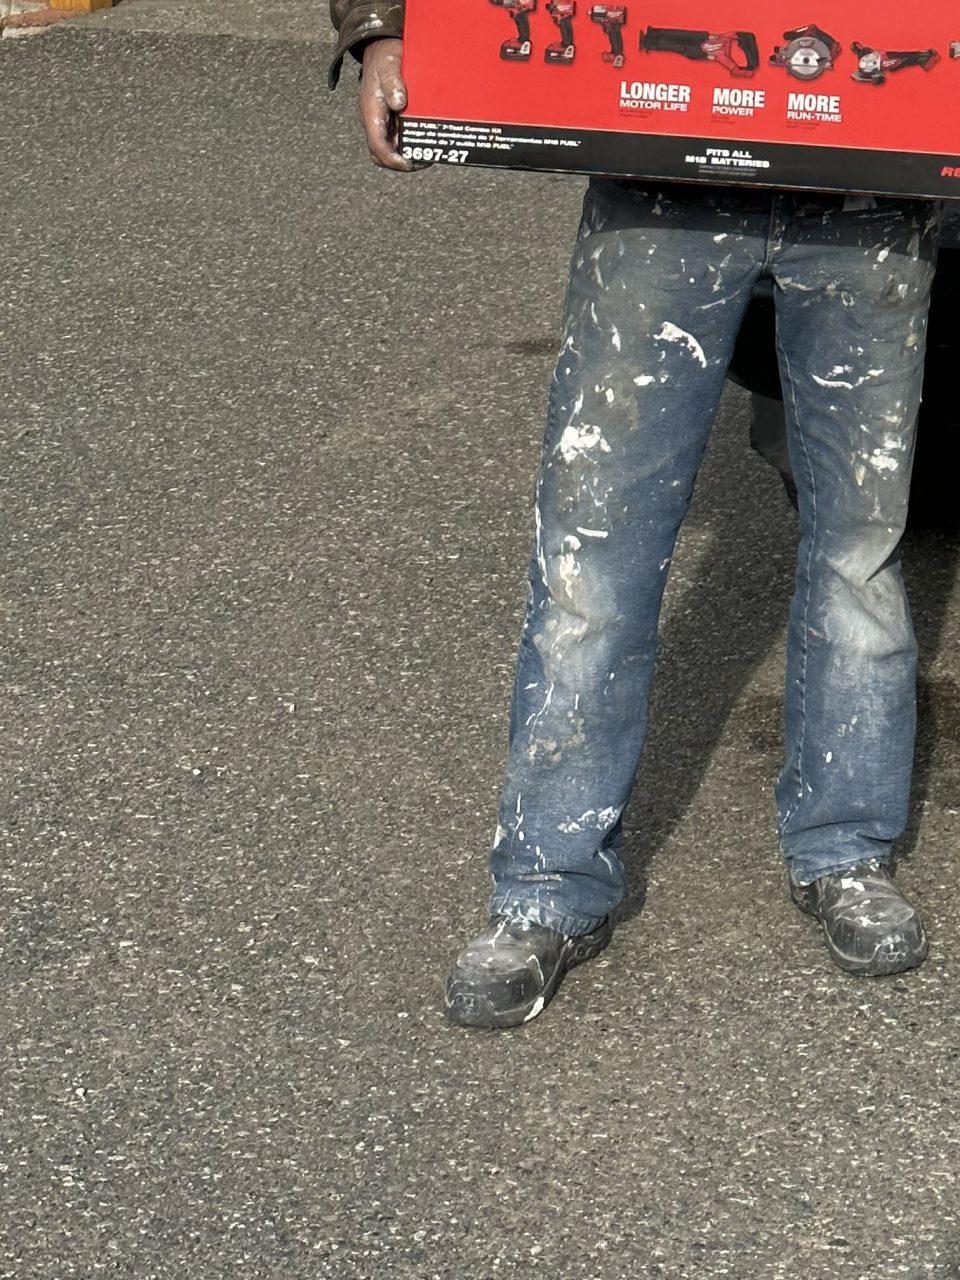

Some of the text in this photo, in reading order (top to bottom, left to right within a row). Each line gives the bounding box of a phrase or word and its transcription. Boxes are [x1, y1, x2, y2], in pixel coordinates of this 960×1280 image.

[620, 81, 691, 103] LONGER
[712, 87, 765, 108] MORE
[619, 99, 688, 112] MOTOR LIFE
[787, 93, 840, 113] MORE
[712, 105, 754, 117] POWER
[787, 111, 842, 123] RUN-TIME
[402, 146, 469, 163] 3697-27
[706, 148, 752, 159] FITS ALL
[710, 157, 770, 168] BATTERIES
